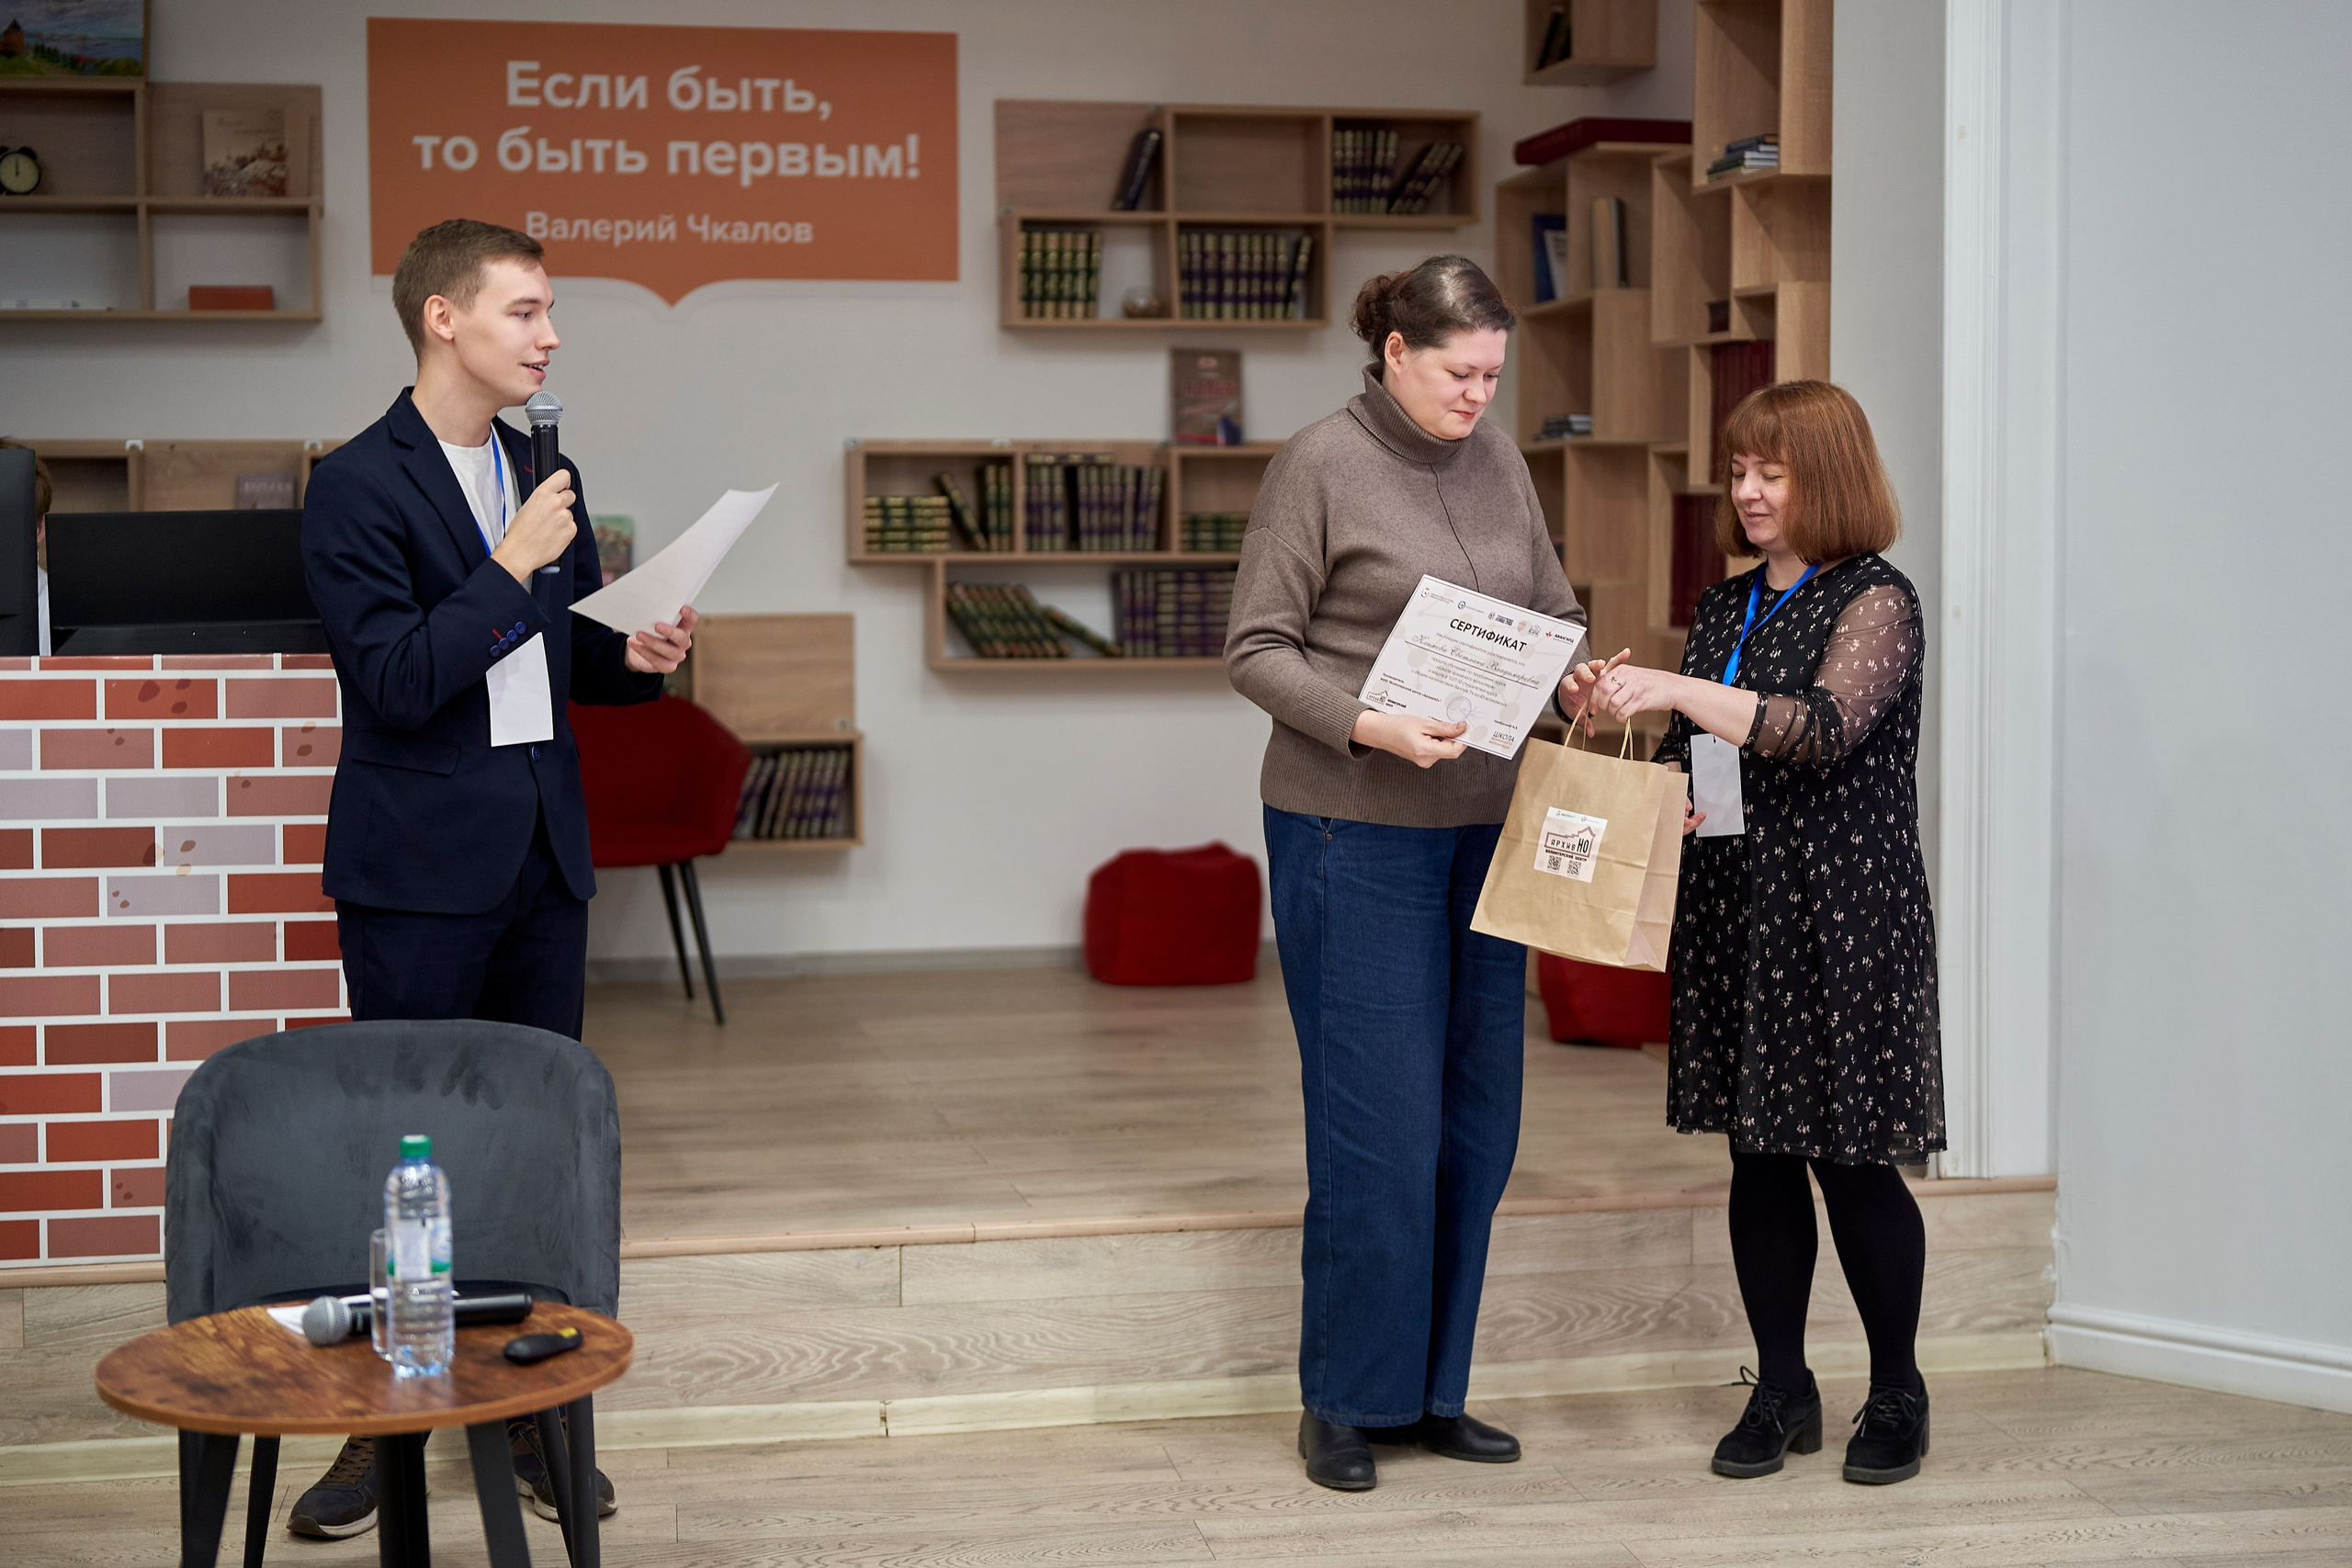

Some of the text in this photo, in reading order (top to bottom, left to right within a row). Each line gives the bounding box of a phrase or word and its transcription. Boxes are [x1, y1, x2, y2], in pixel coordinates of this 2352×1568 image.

[507, 62, 831, 119] Если быть,
[412, 126, 919, 187] то быть первым!
[526, 211, 813, 246] Валерий Чкалов
[1451, 619, 1526, 651] СЕРТИФИКАТ
[1493, 731, 1514, 742] ШКОЛА
